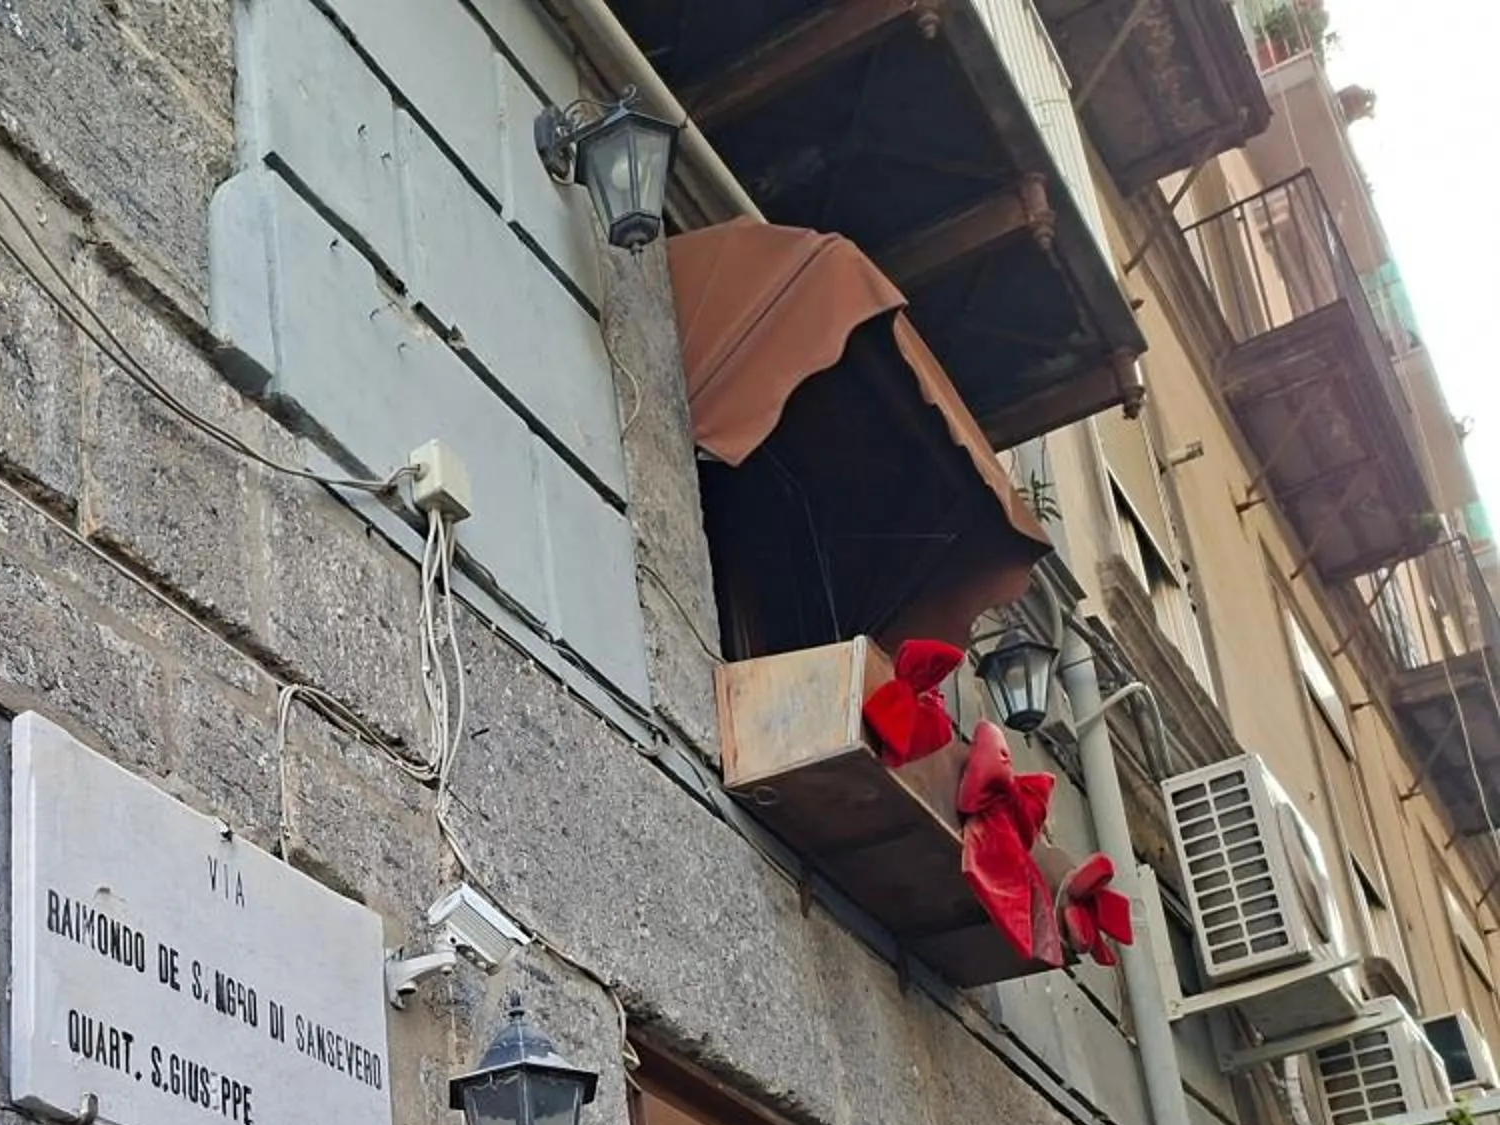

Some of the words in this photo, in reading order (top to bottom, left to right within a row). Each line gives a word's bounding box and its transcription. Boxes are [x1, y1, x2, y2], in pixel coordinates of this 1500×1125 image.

[207, 854, 246, 908] VIA
[47, 889, 145, 973] RAIMONDO
[158, 942, 181, 992] DE
[192, 960, 257, 1029] SNGRO
[269, 1000, 285, 1044] DI
[295, 1013, 383, 1091] SANSEVERO
[68, 1009, 142, 1082] QUART.
